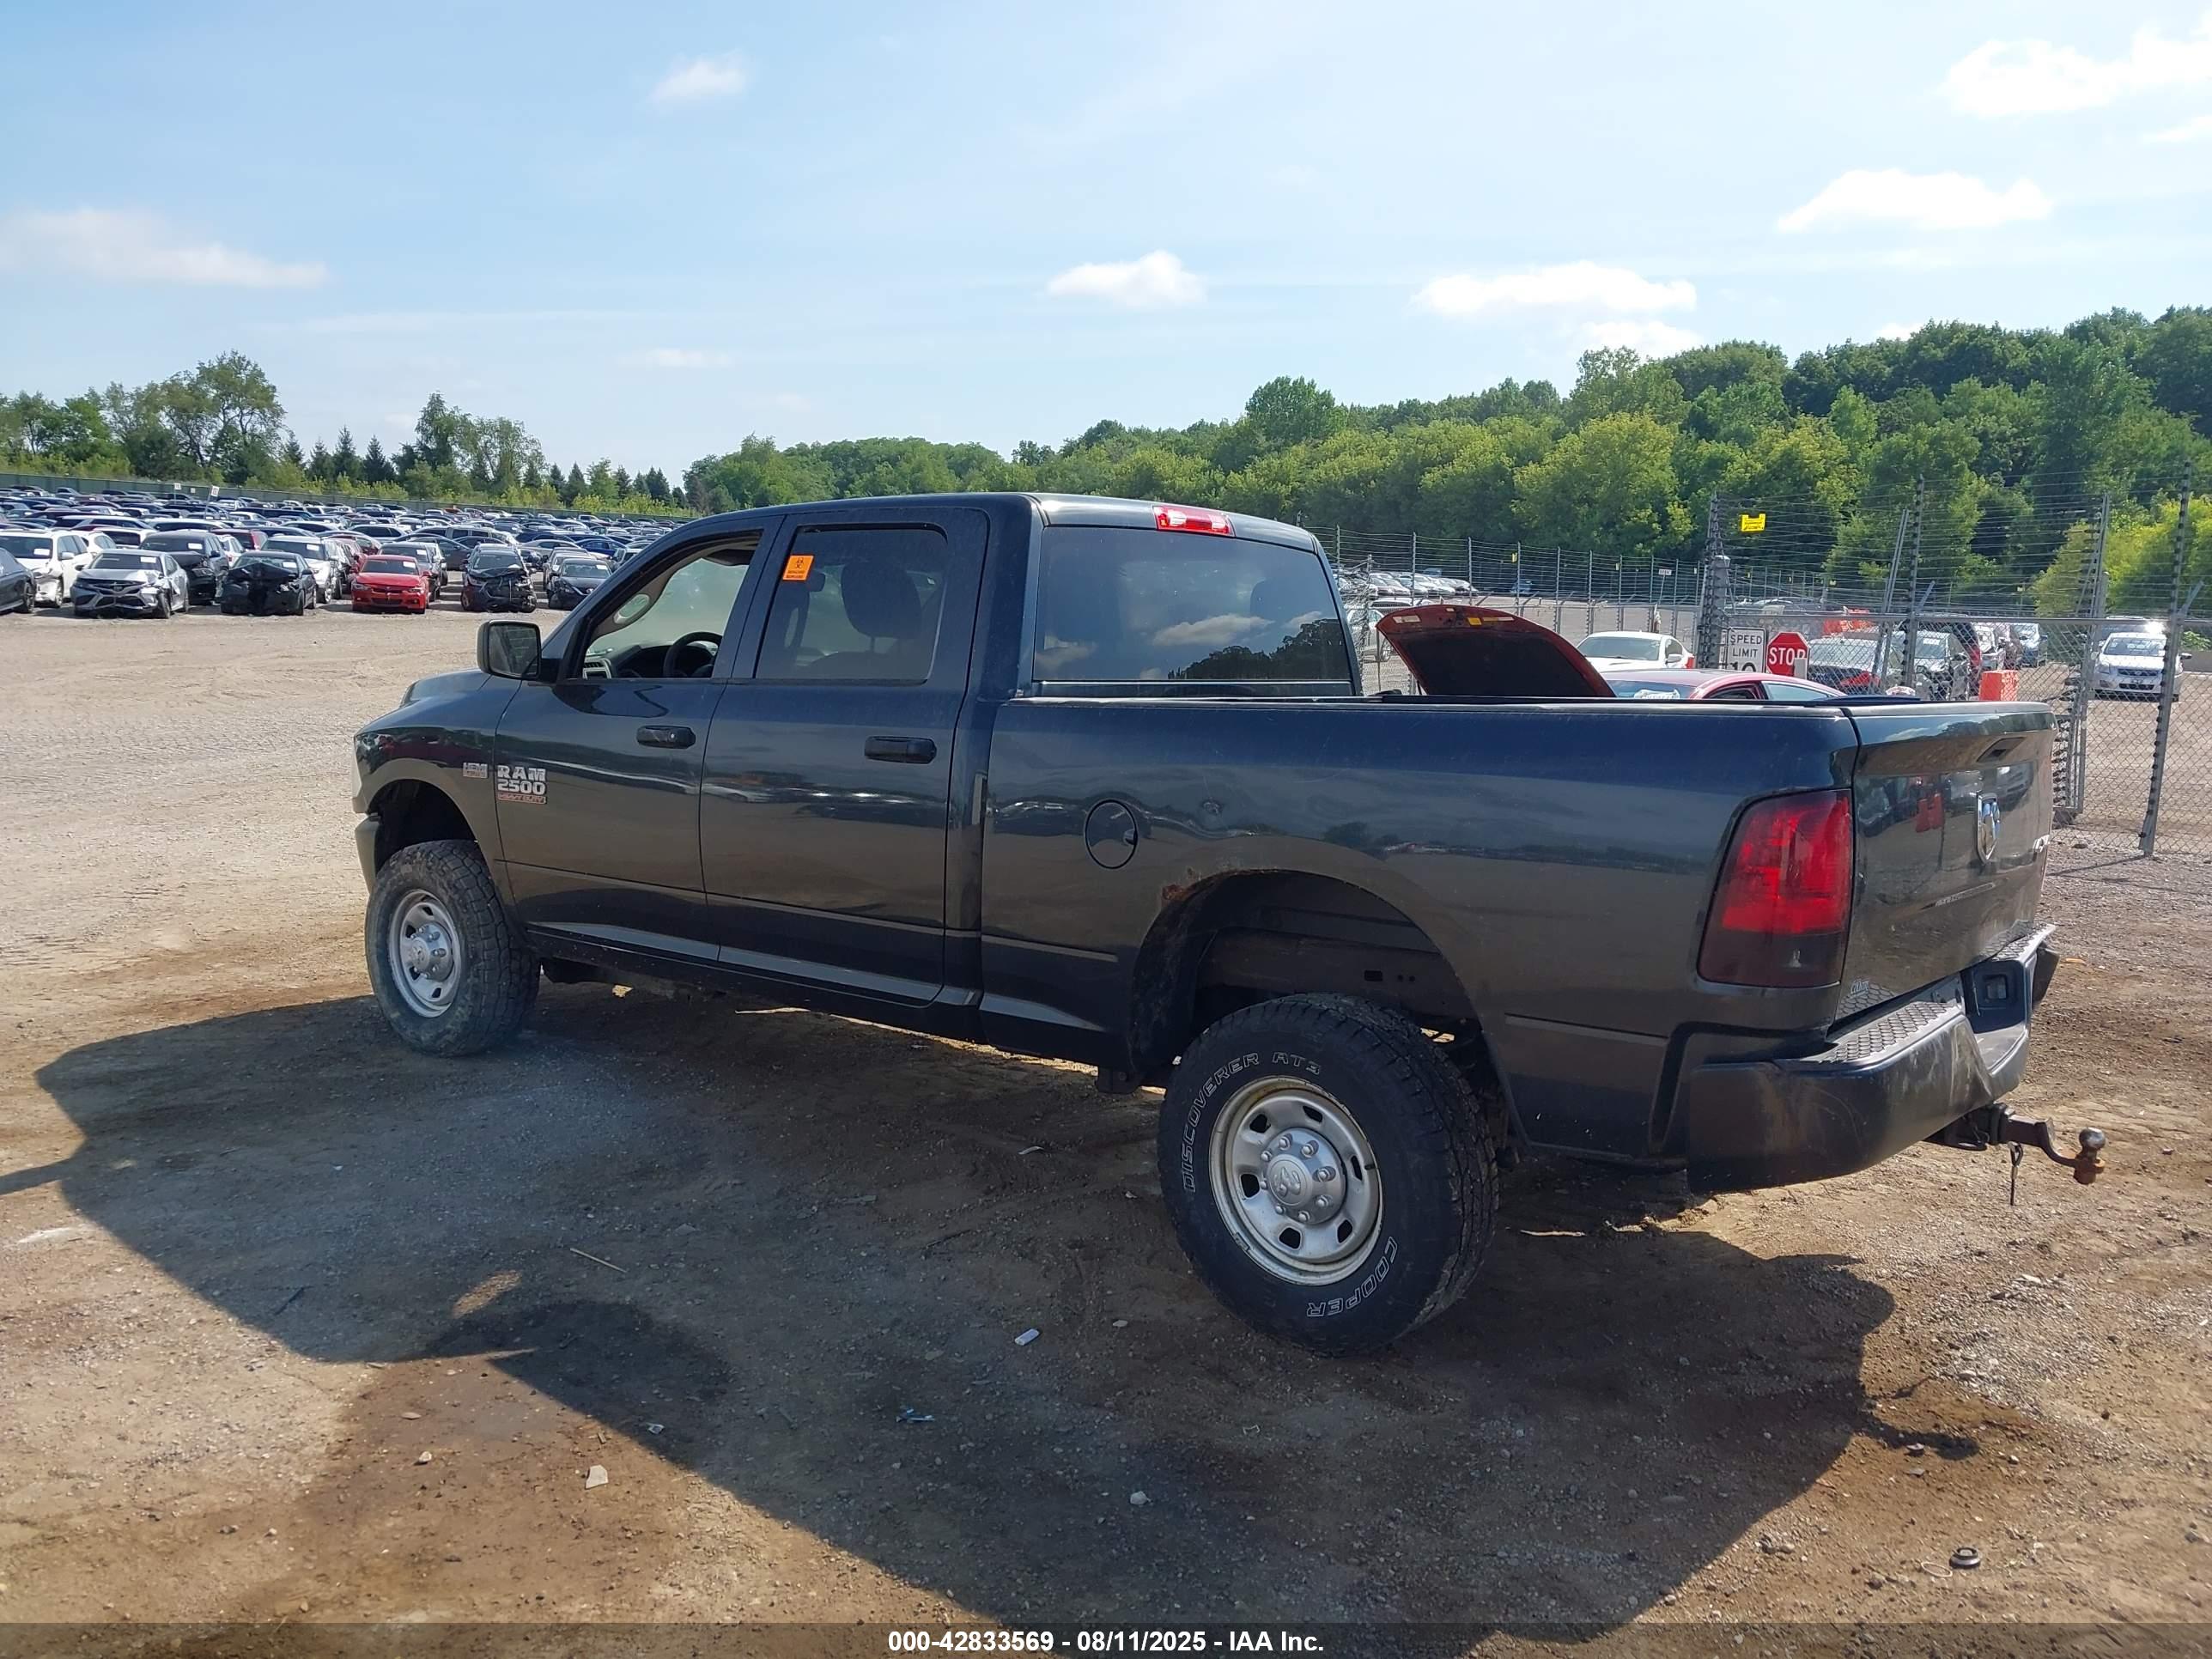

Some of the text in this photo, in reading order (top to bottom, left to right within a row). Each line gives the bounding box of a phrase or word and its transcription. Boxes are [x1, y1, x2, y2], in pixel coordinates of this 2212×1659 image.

[1729, 635, 1763, 645] SPEED
[1732, 647, 1759, 658] LIMIT
[1769, 647, 1806, 665] STOP
[497, 764, 546, 782] RAM
[497, 778, 546, 795] 2500
[1182, 1051, 1322, 1193] DISCOVERER AT3
[1306, 1236, 1398, 1317] COOPER
